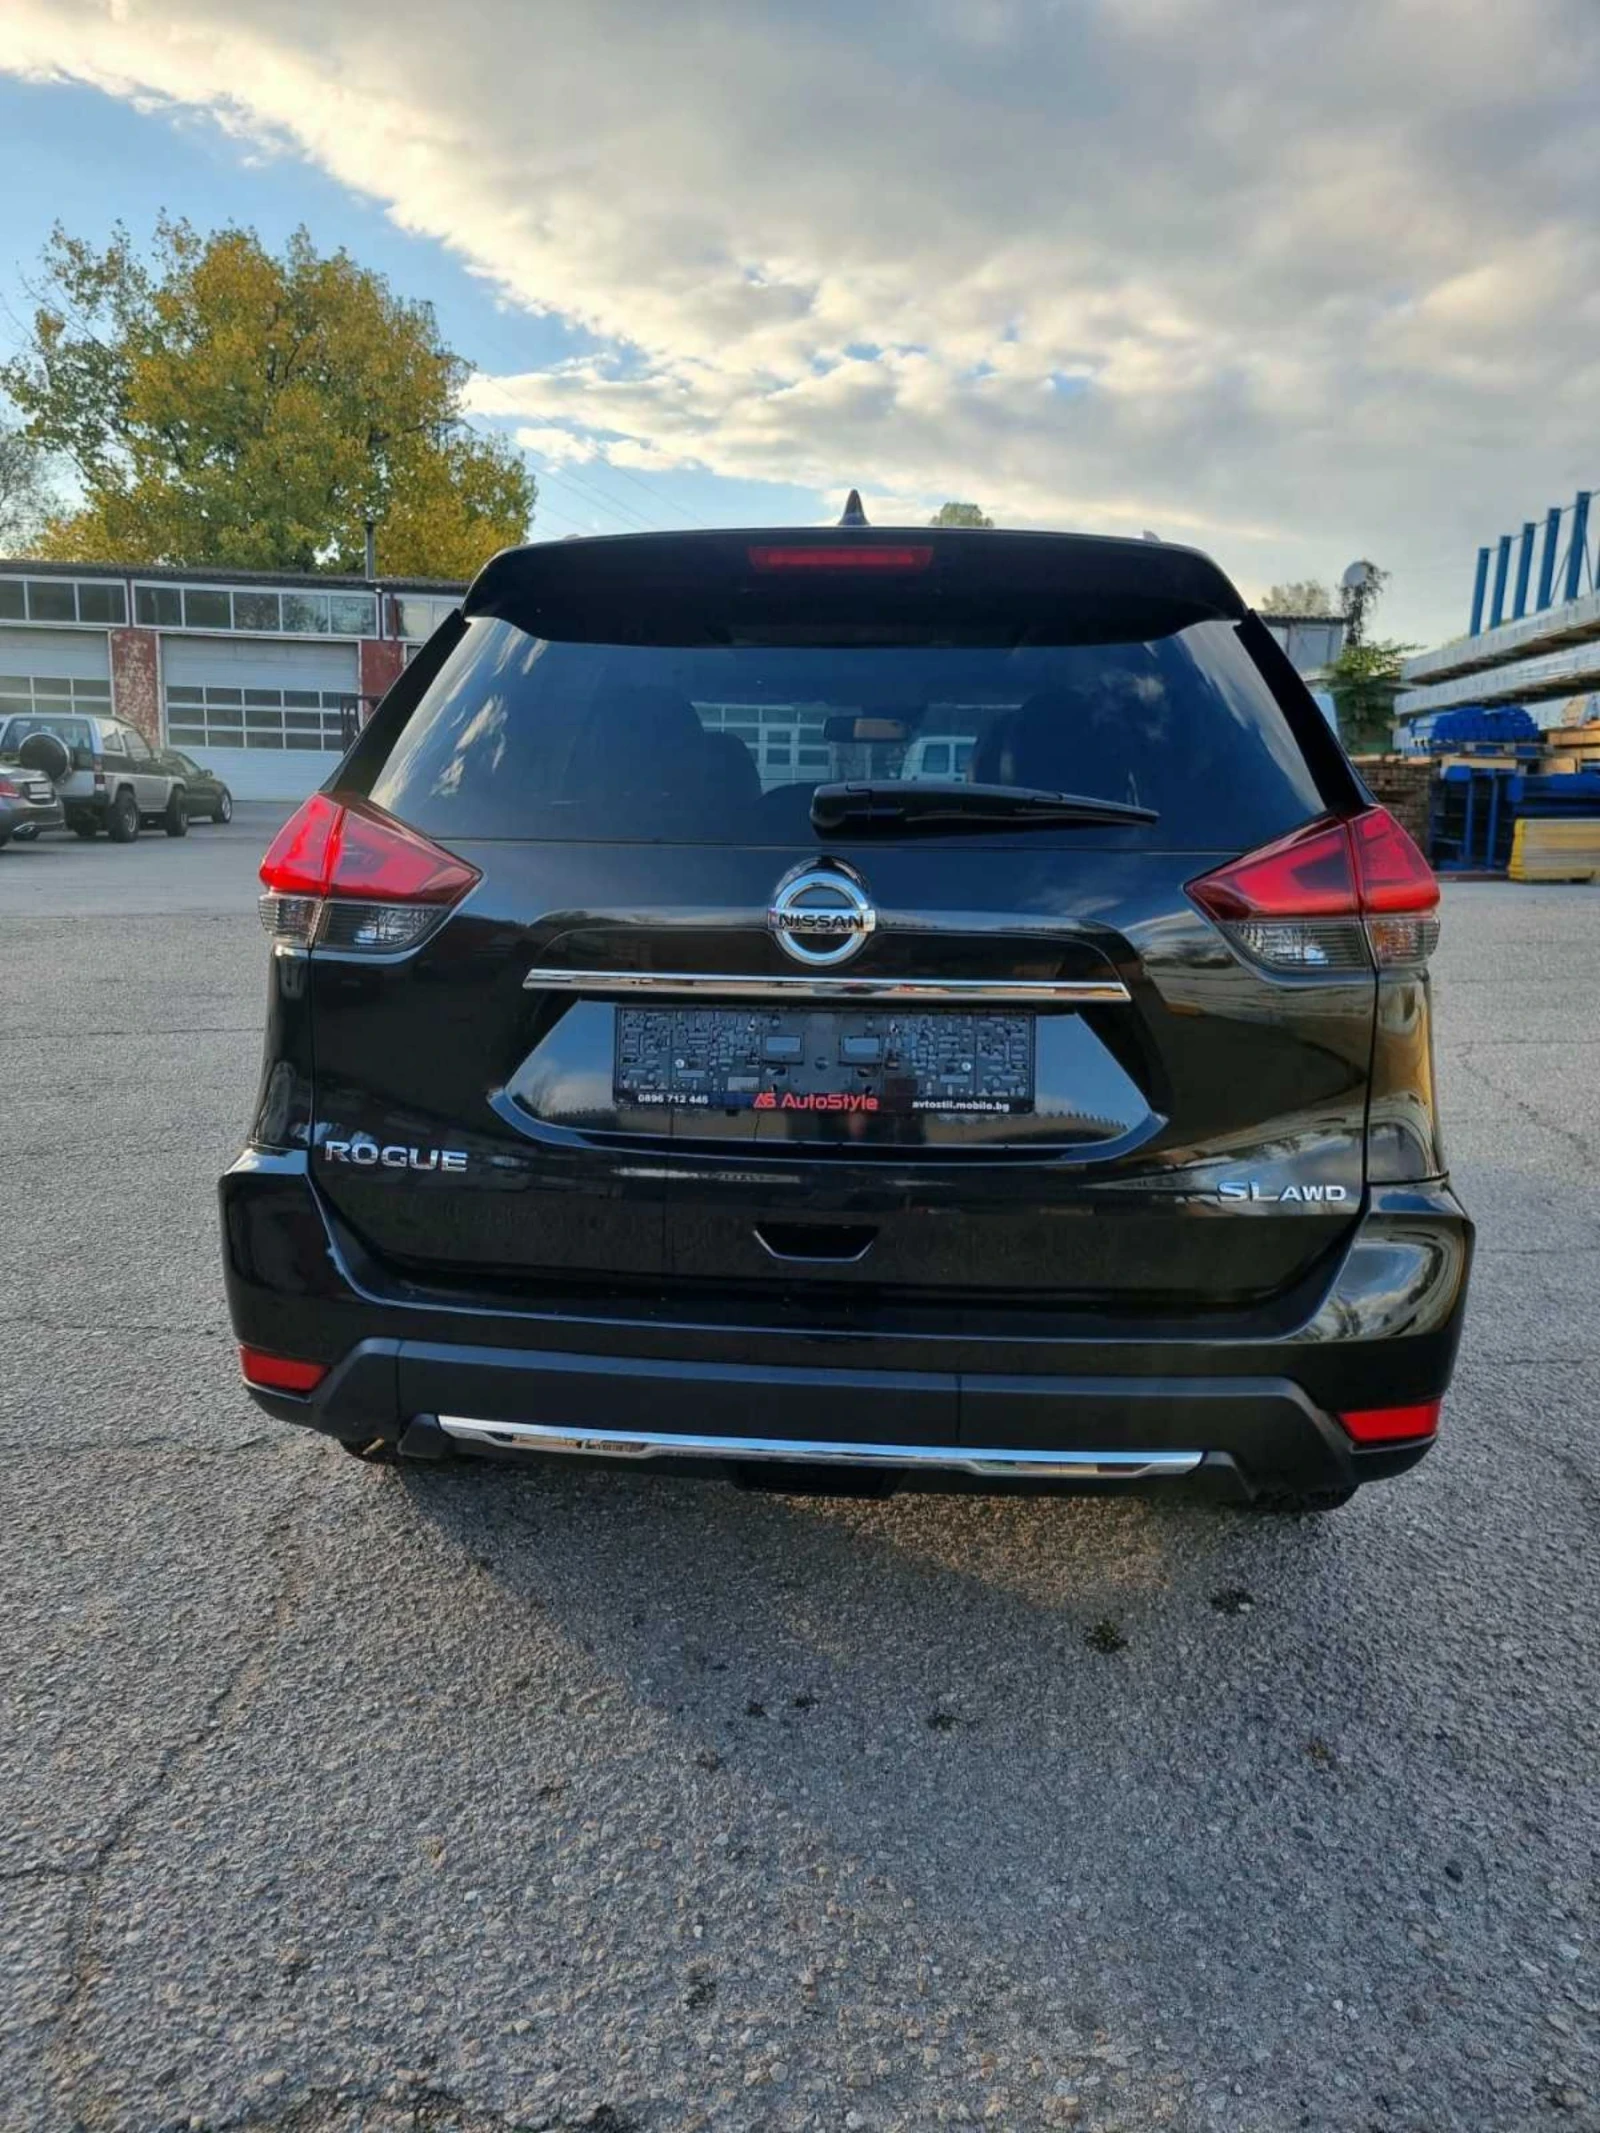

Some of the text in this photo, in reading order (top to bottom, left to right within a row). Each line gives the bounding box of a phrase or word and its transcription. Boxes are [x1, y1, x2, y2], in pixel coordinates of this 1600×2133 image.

[778, 913, 865, 929] NISSAN
[667, 1095, 686, 1104] 712
[781, 1092, 878, 1111] AutoStyle
[912, 1100, 1010, 1112] avtostil.mobile.bg
[325, 1140, 468, 1173] ROGUE
[1219, 1181, 1347, 1201] SL AWD
